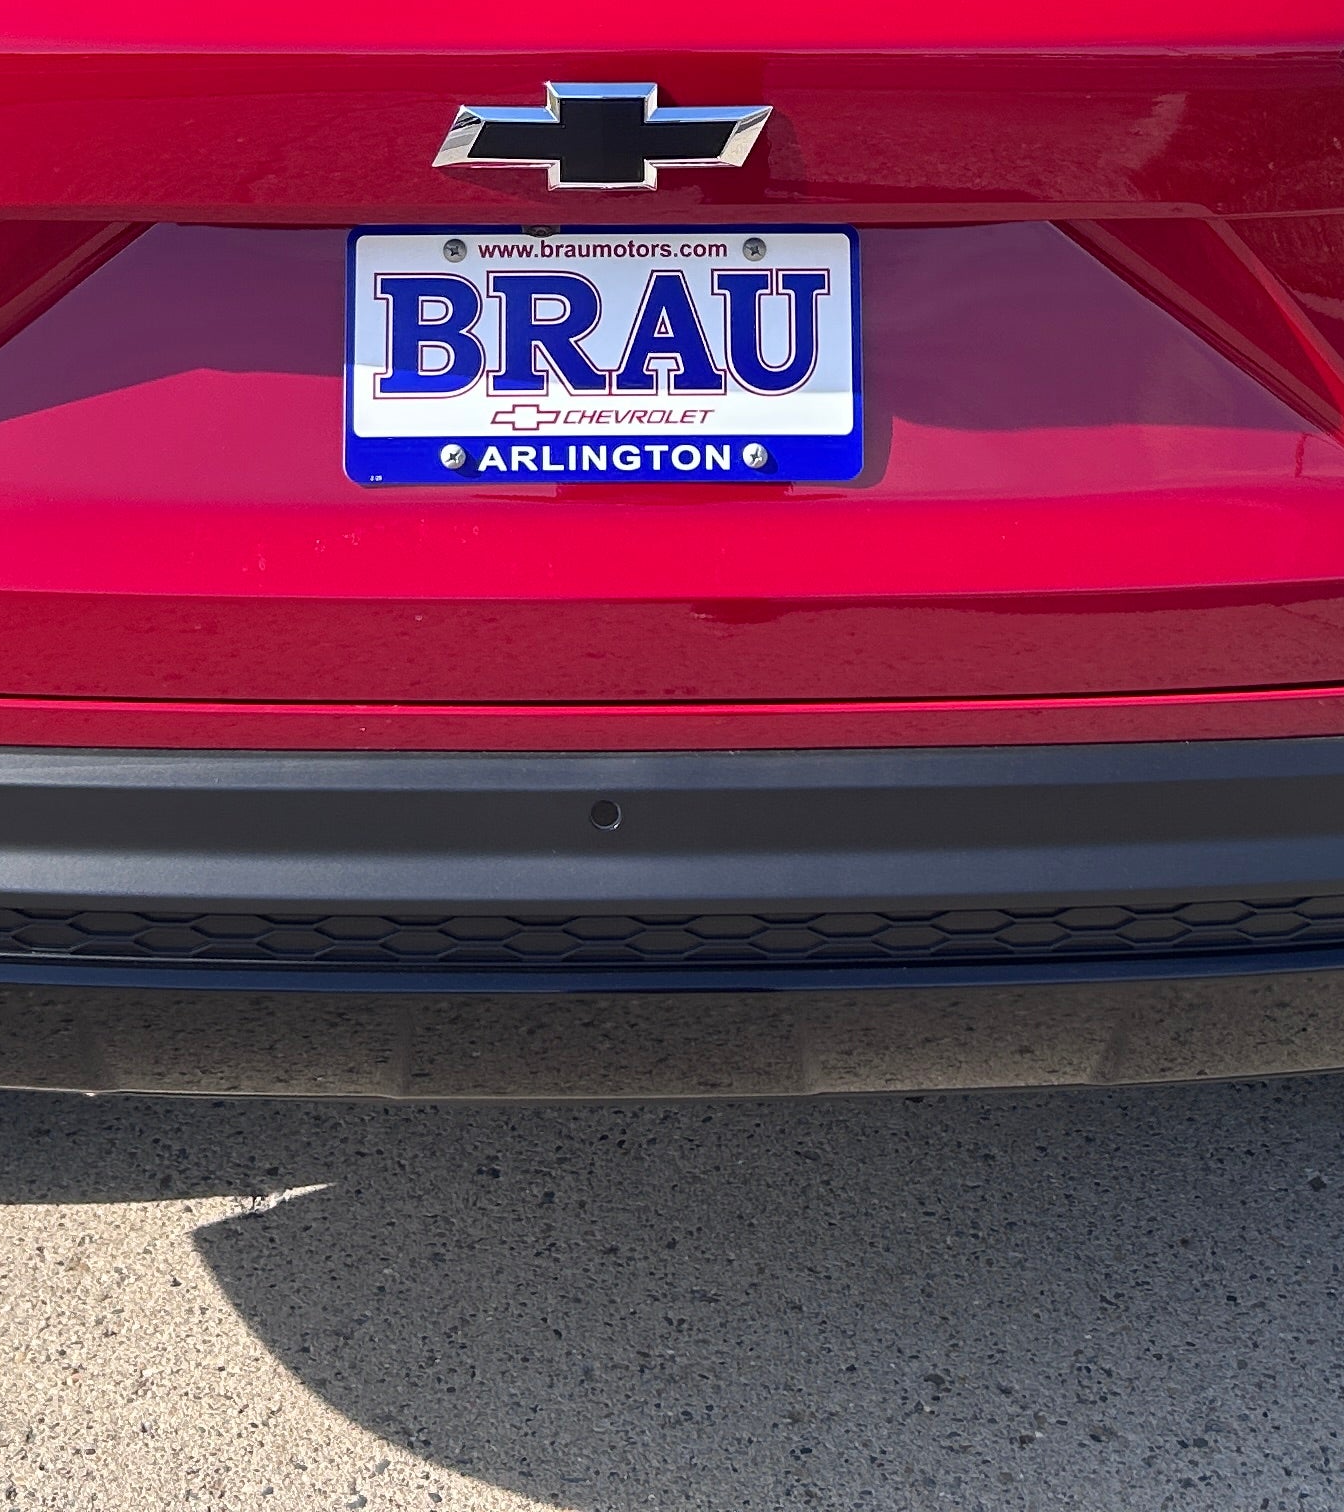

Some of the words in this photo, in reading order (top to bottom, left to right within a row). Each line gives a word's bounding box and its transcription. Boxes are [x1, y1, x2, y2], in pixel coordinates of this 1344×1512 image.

[478, 240, 728, 259] www.braumotors.com
[373, 268, 830, 399] BRAU
[563, 408, 715, 425] CHEVROLET
[477, 443, 732, 472] ARLINGTON
